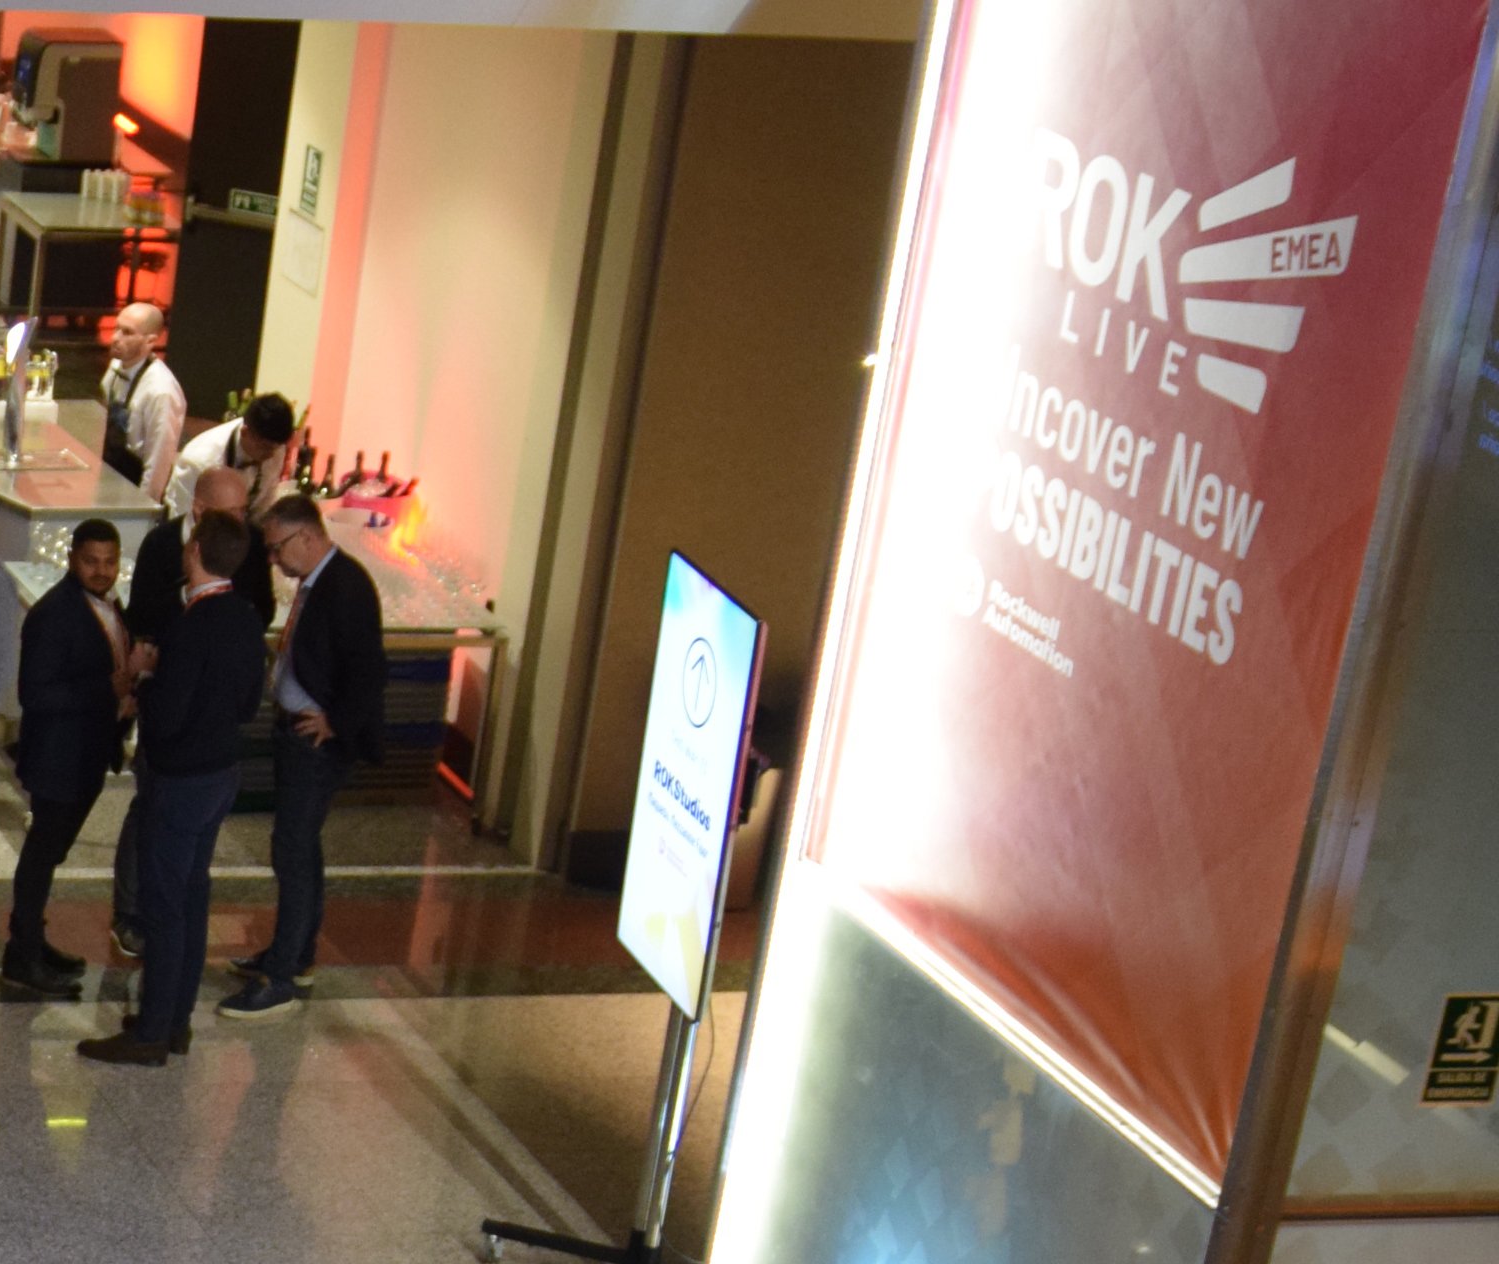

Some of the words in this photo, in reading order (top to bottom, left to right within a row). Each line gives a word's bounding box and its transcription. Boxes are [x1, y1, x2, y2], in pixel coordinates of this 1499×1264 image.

[1034, 127, 1192, 322] ROK
[1271, 231, 1342, 272] EMEA
[1060, 290, 1187, 396] LIVE
[1160, 432, 1264, 560] New
[989, 580, 1061, 641] Rockwell
[991, 450, 1244, 665] OSSIBILITIES
[982, 603, 1074, 677] Automation
